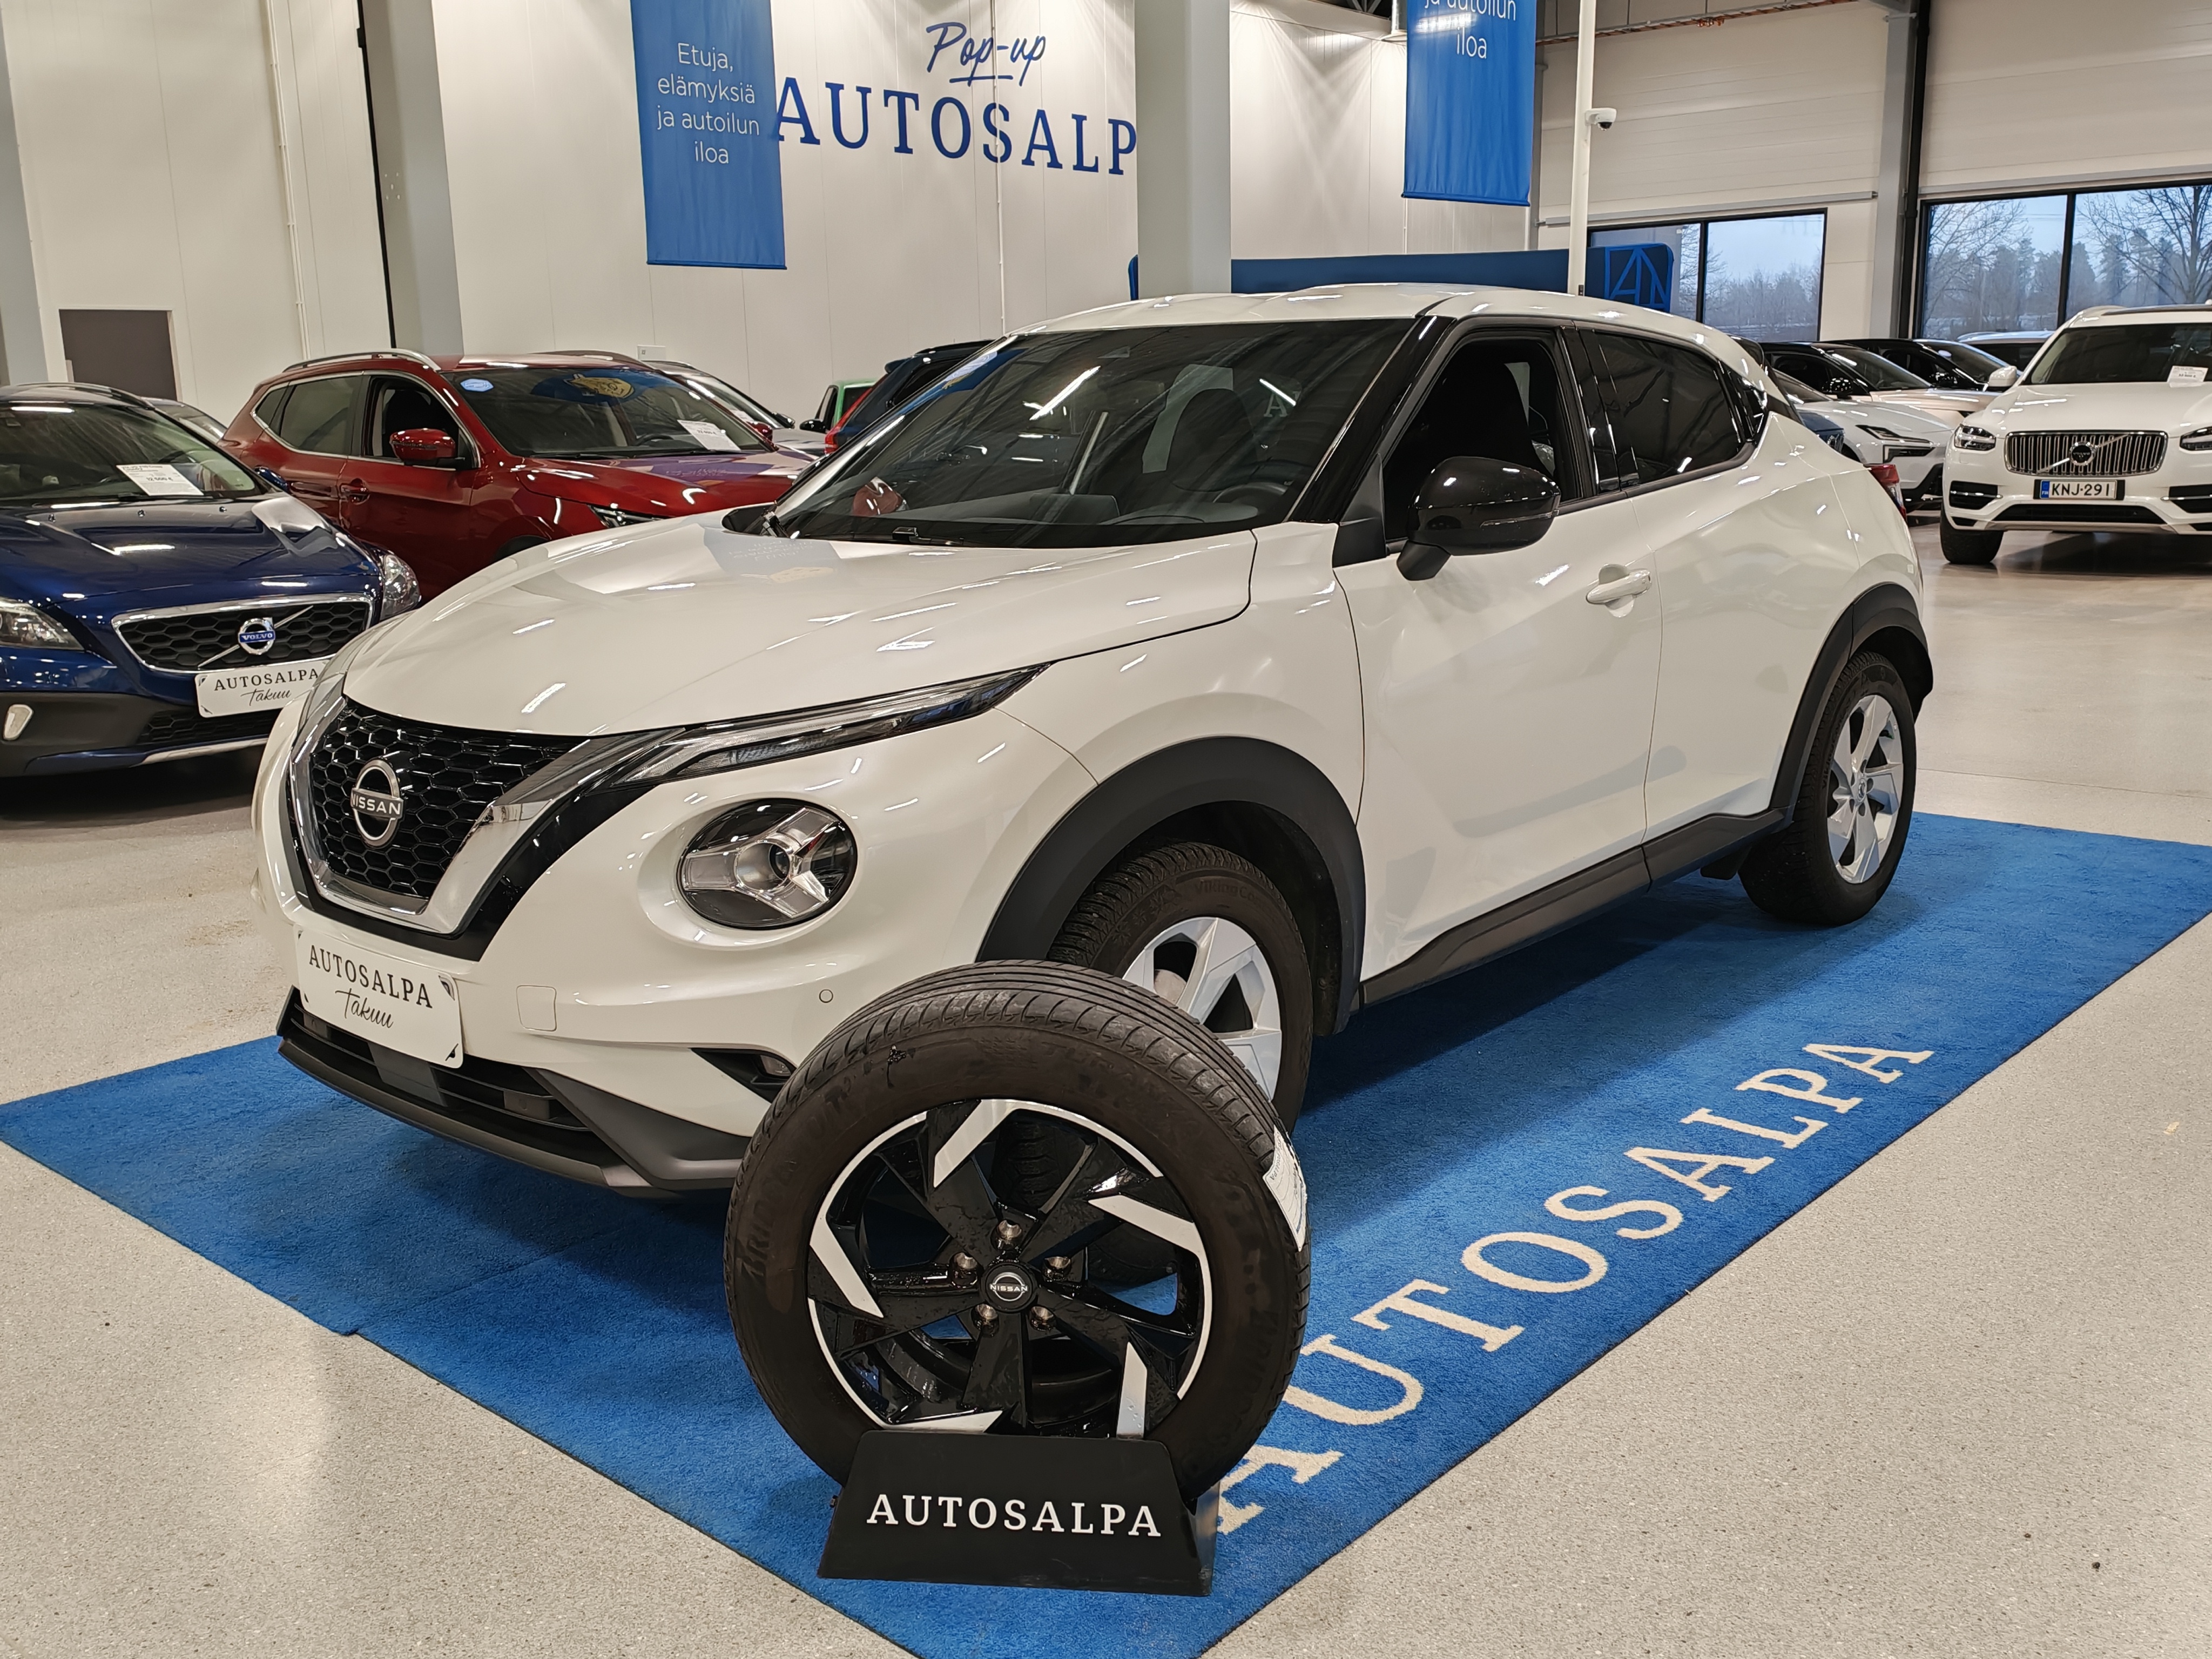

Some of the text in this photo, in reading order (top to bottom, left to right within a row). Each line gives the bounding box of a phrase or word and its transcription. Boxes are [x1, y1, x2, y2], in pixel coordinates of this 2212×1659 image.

[678, 42, 733, 72] Etuja,
[926, 22, 1046, 87] Pop-up
[1457, 26, 1487, 59] iloa
[657, 73, 756, 104] elämyksiä
[657, 105, 759, 136] ja autoilun
[775, 77, 1136, 176] AUTOSALP
[694, 140, 729, 164] iloa
[2053, 483, 2109, 496] KNJ-291
[214, 668, 319, 691] AUTOSALPA
[240, 688, 292, 706] Takuu
[350, 790, 401, 815] NISSAN
[309, 945, 433, 1009] AUTOSALPA
[335, 988, 394, 1028] Takuu
[990, 1284, 1028, 1292] NISSAN
[866, 1494, 1161, 1537] AUTOSALPA
